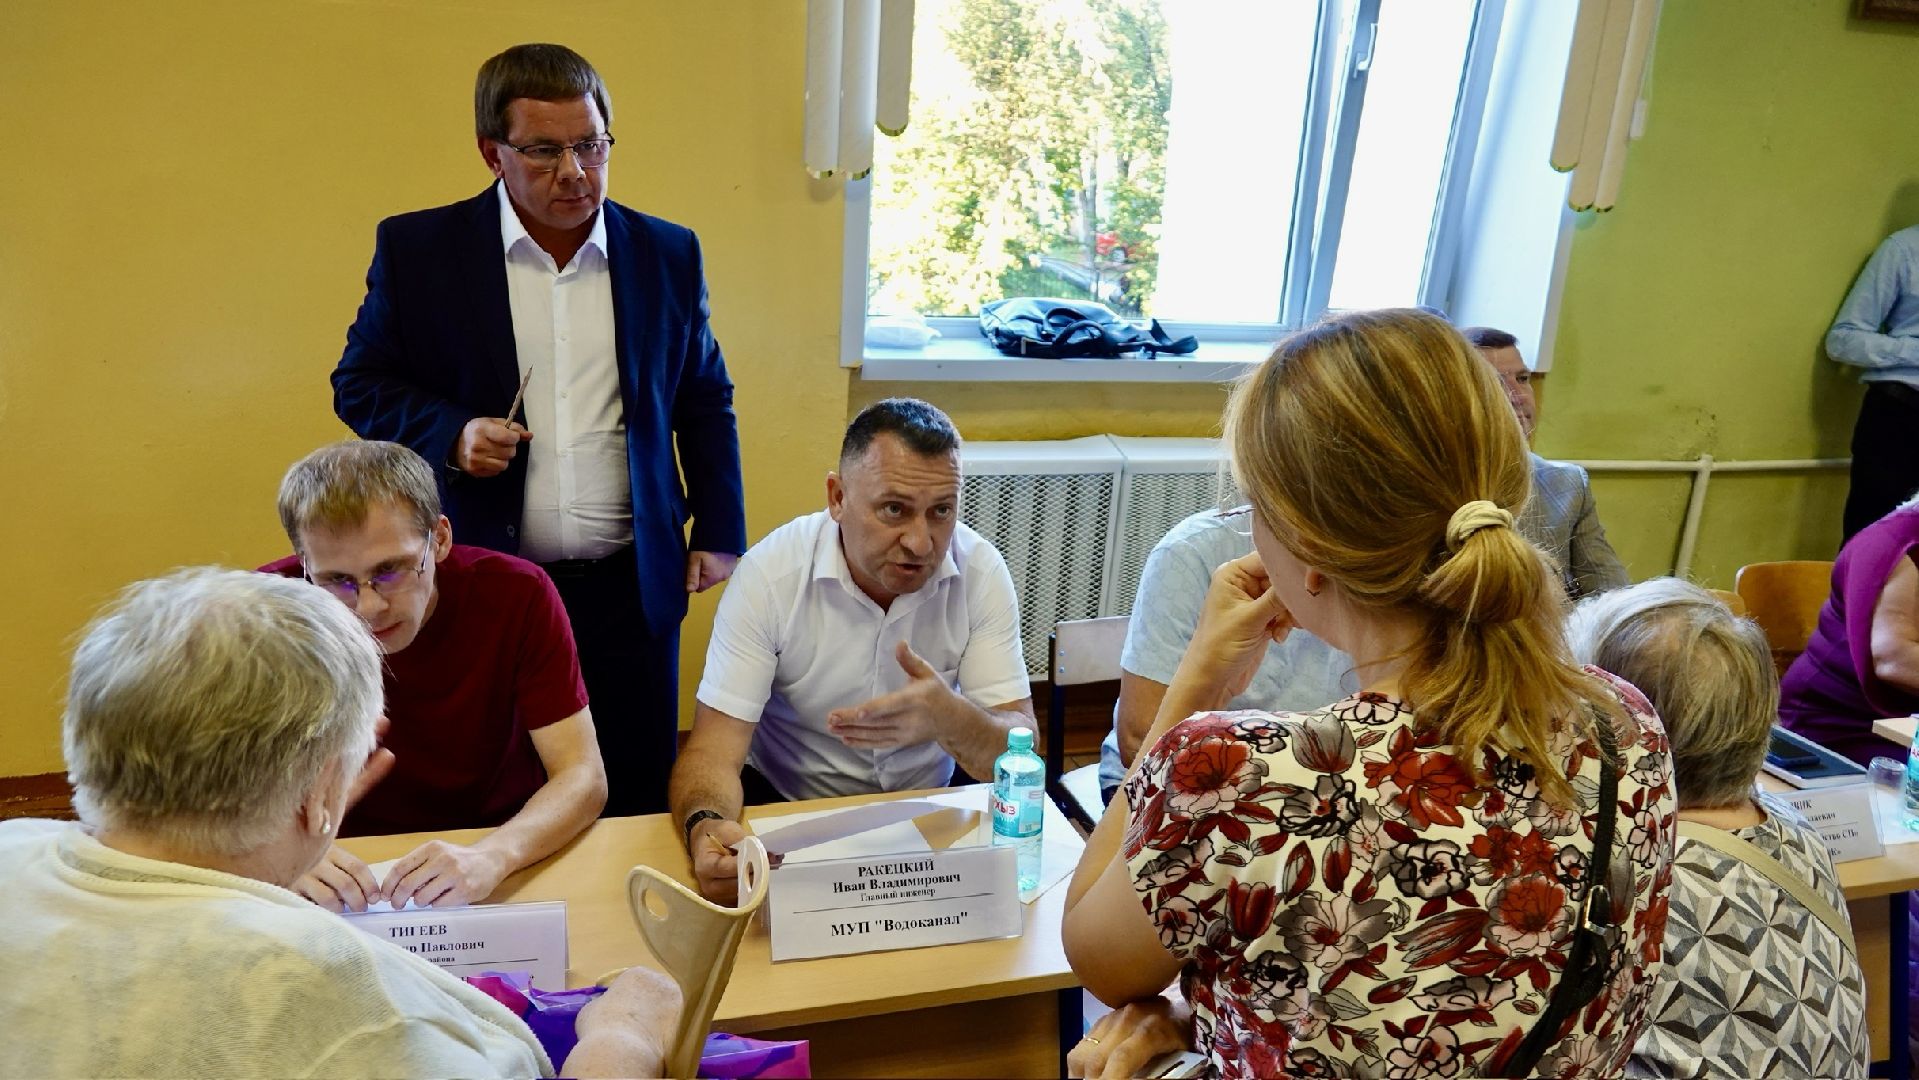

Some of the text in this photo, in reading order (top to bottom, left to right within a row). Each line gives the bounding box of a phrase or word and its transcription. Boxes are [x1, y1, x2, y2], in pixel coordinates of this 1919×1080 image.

[857, 858, 935, 877] РАКЕЦКИЙ
[833, 872, 961, 894] Иван Владимирович
[860, 887, 936, 902] Главный инженер
[388, 924, 447, 938] ТИГЕЕВ
[831, 911, 968, 937] МУП "Водоканал"
[421, 941, 485, 953] Павлович
